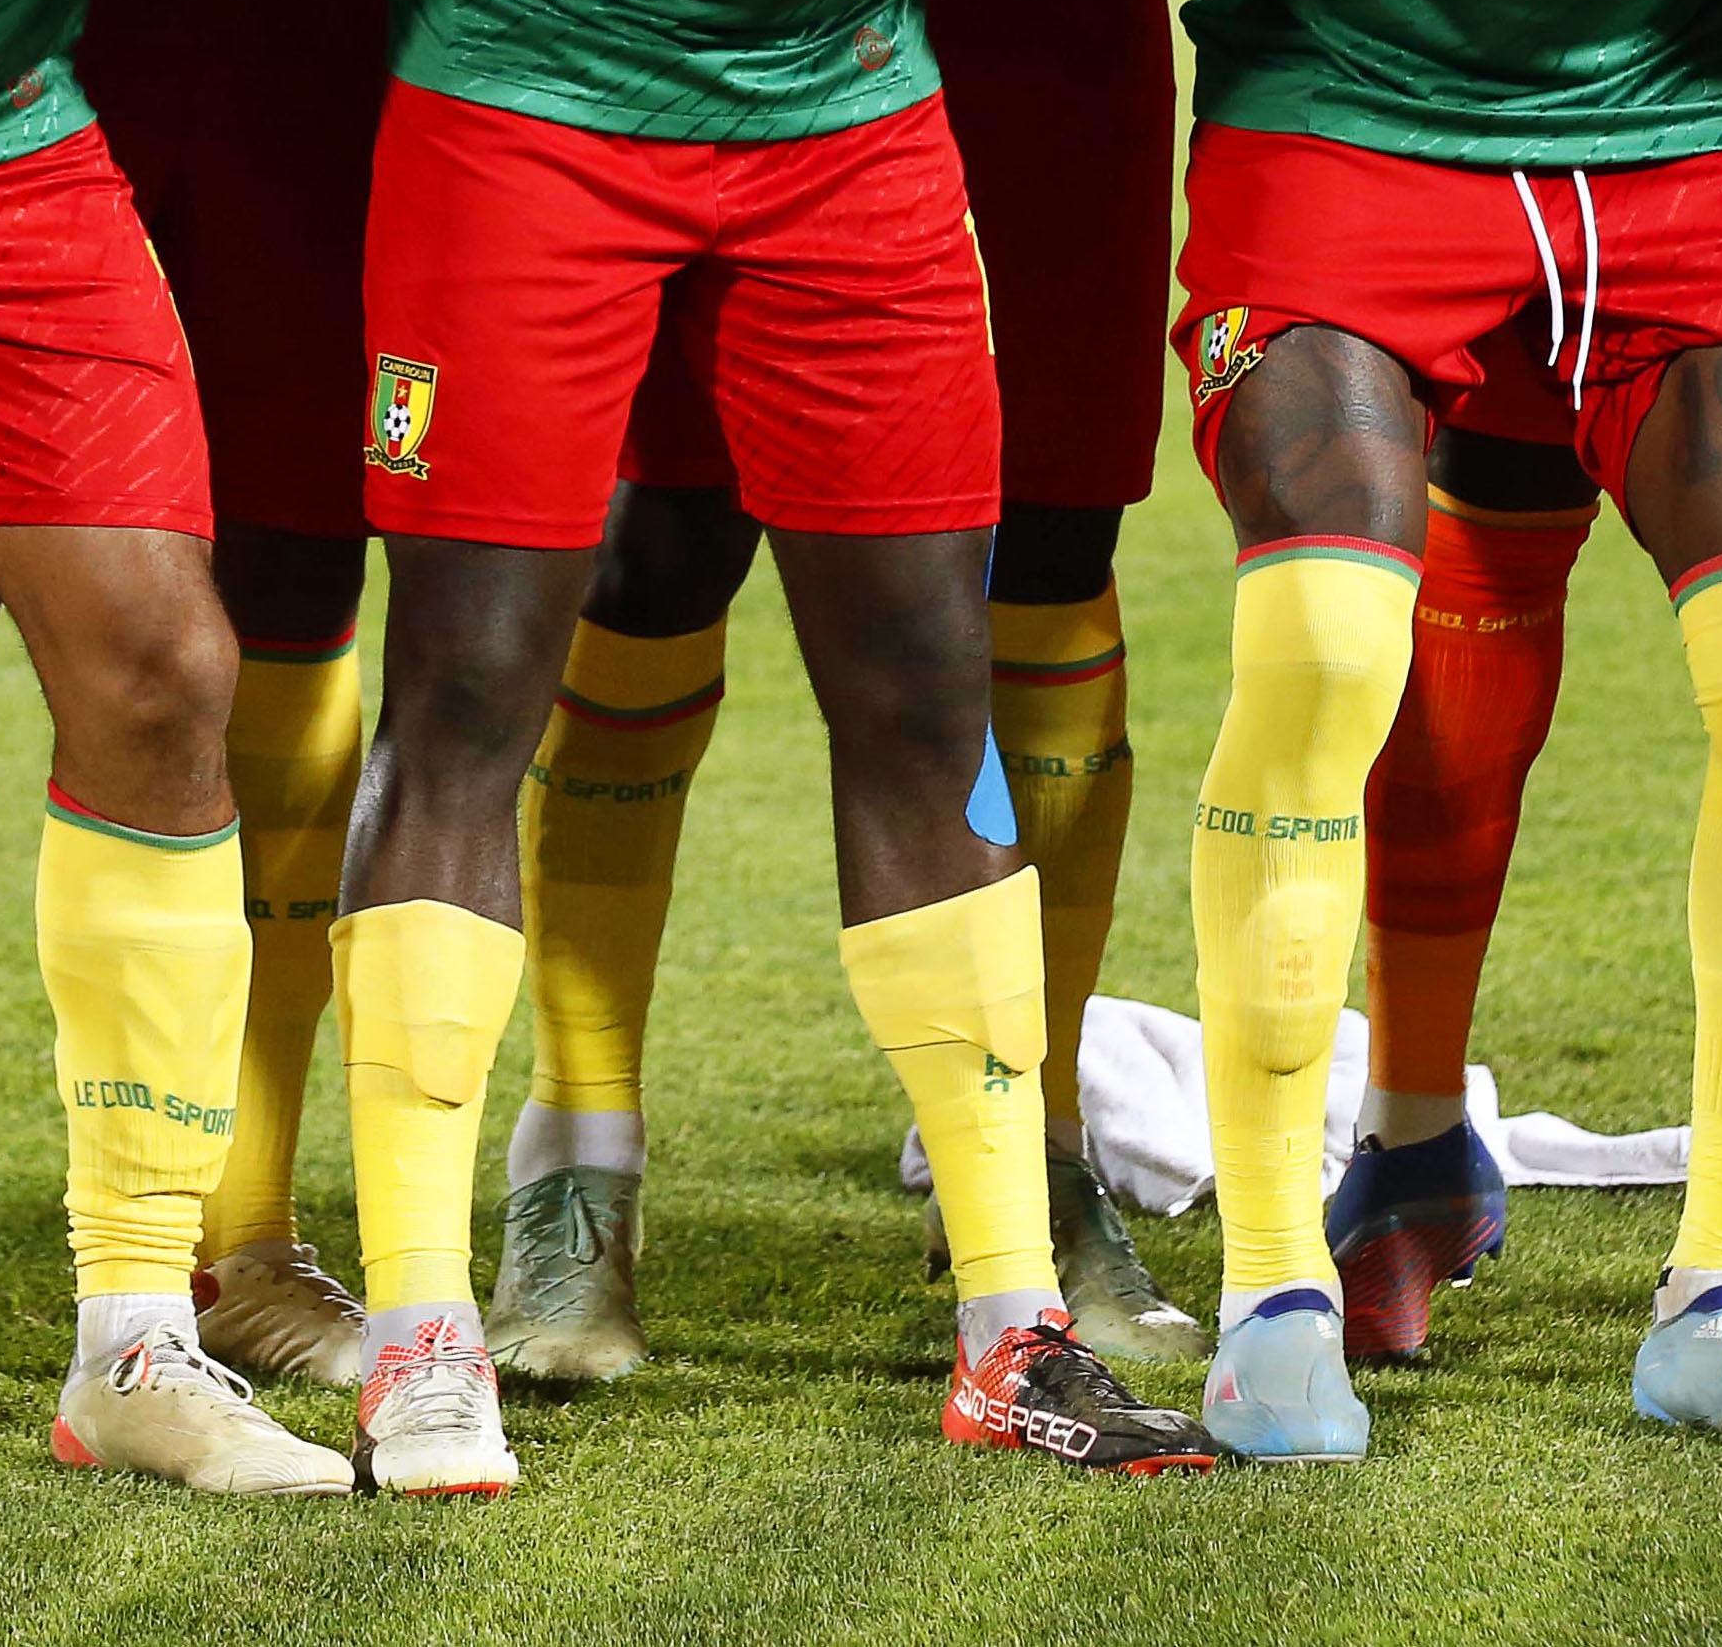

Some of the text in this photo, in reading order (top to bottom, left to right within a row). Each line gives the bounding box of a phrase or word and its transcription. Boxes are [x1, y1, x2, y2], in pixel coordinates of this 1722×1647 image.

[382, 359, 432, 382] CAMEROUN
[561, 768, 689, 803] SPORTIF
[75, 1081, 100, 1107] LE
